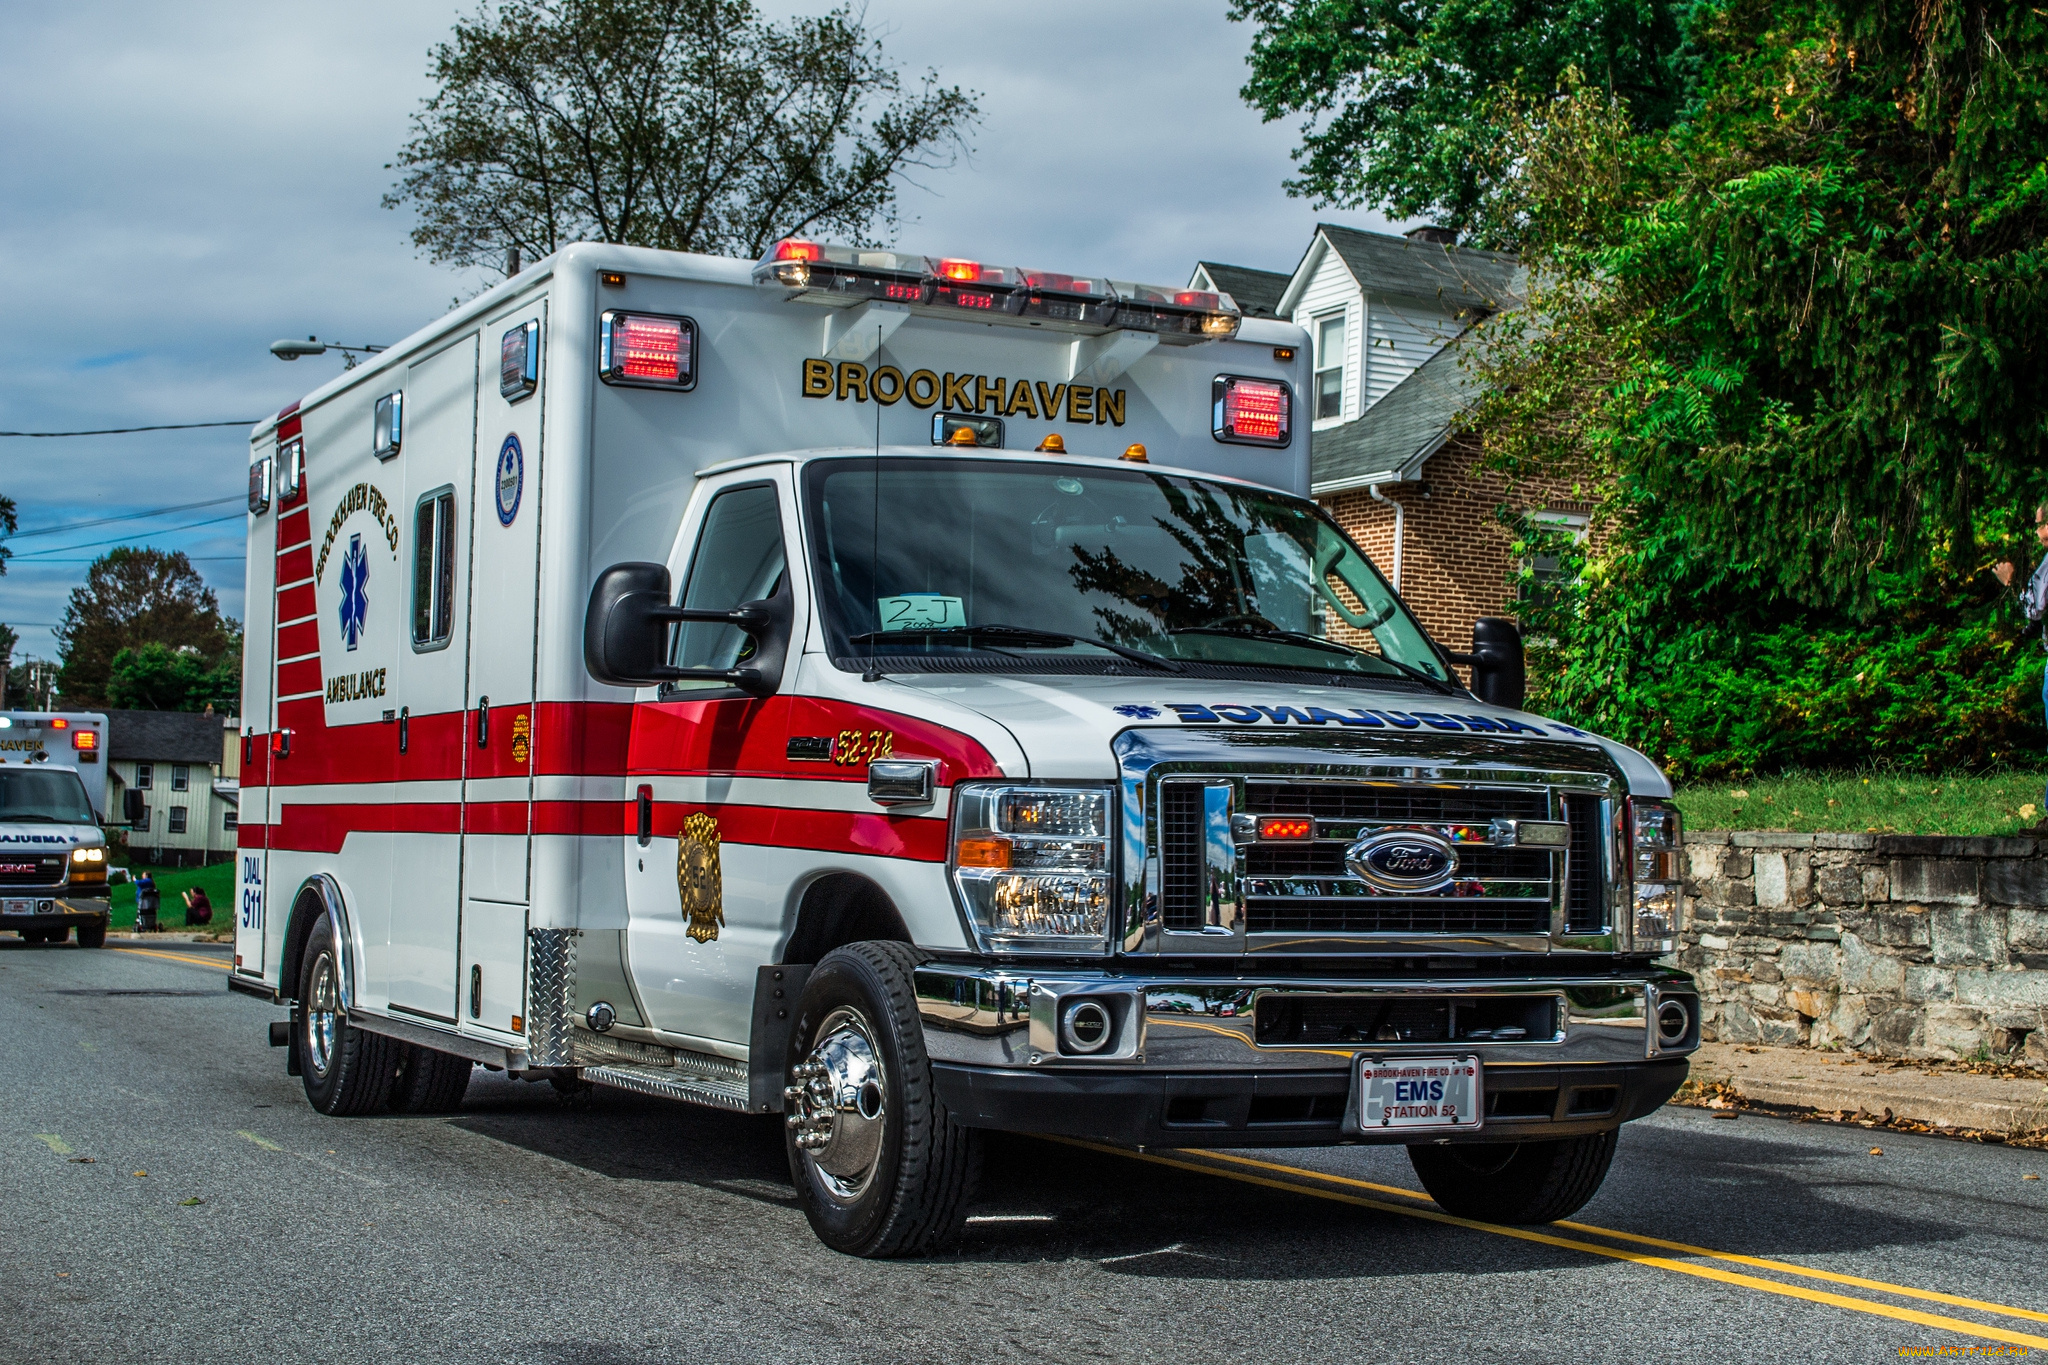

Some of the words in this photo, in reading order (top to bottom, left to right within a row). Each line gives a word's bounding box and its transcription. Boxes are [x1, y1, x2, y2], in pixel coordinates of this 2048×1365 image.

[802, 358, 1126, 427] BROOKHAVEN
[315, 482, 369, 588] BROOKHAVEN
[367, 484, 388, 528] FIRE
[385, 513, 399, 562] CO.
[324, 667, 387, 705] AMBULANCE
[0, 863, 37, 874] GMC
[243, 856, 262, 885] DIAL
[1385, 846, 1434, 871] Ford
[692, 866, 707, 890] 52
[242, 888, 262, 930] 911
[1373, 1070, 1420, 1078] BROOKHAVEN
[1422, 1068, 1438, 1077] FIRE
[1439, 1067, 1452, 1076] CO.
[1395, 1080, 1443, 1101] EMS
[1384, 1105, 1438, 1118] STATION
[1441, 1104, 1456, 1117] 52
